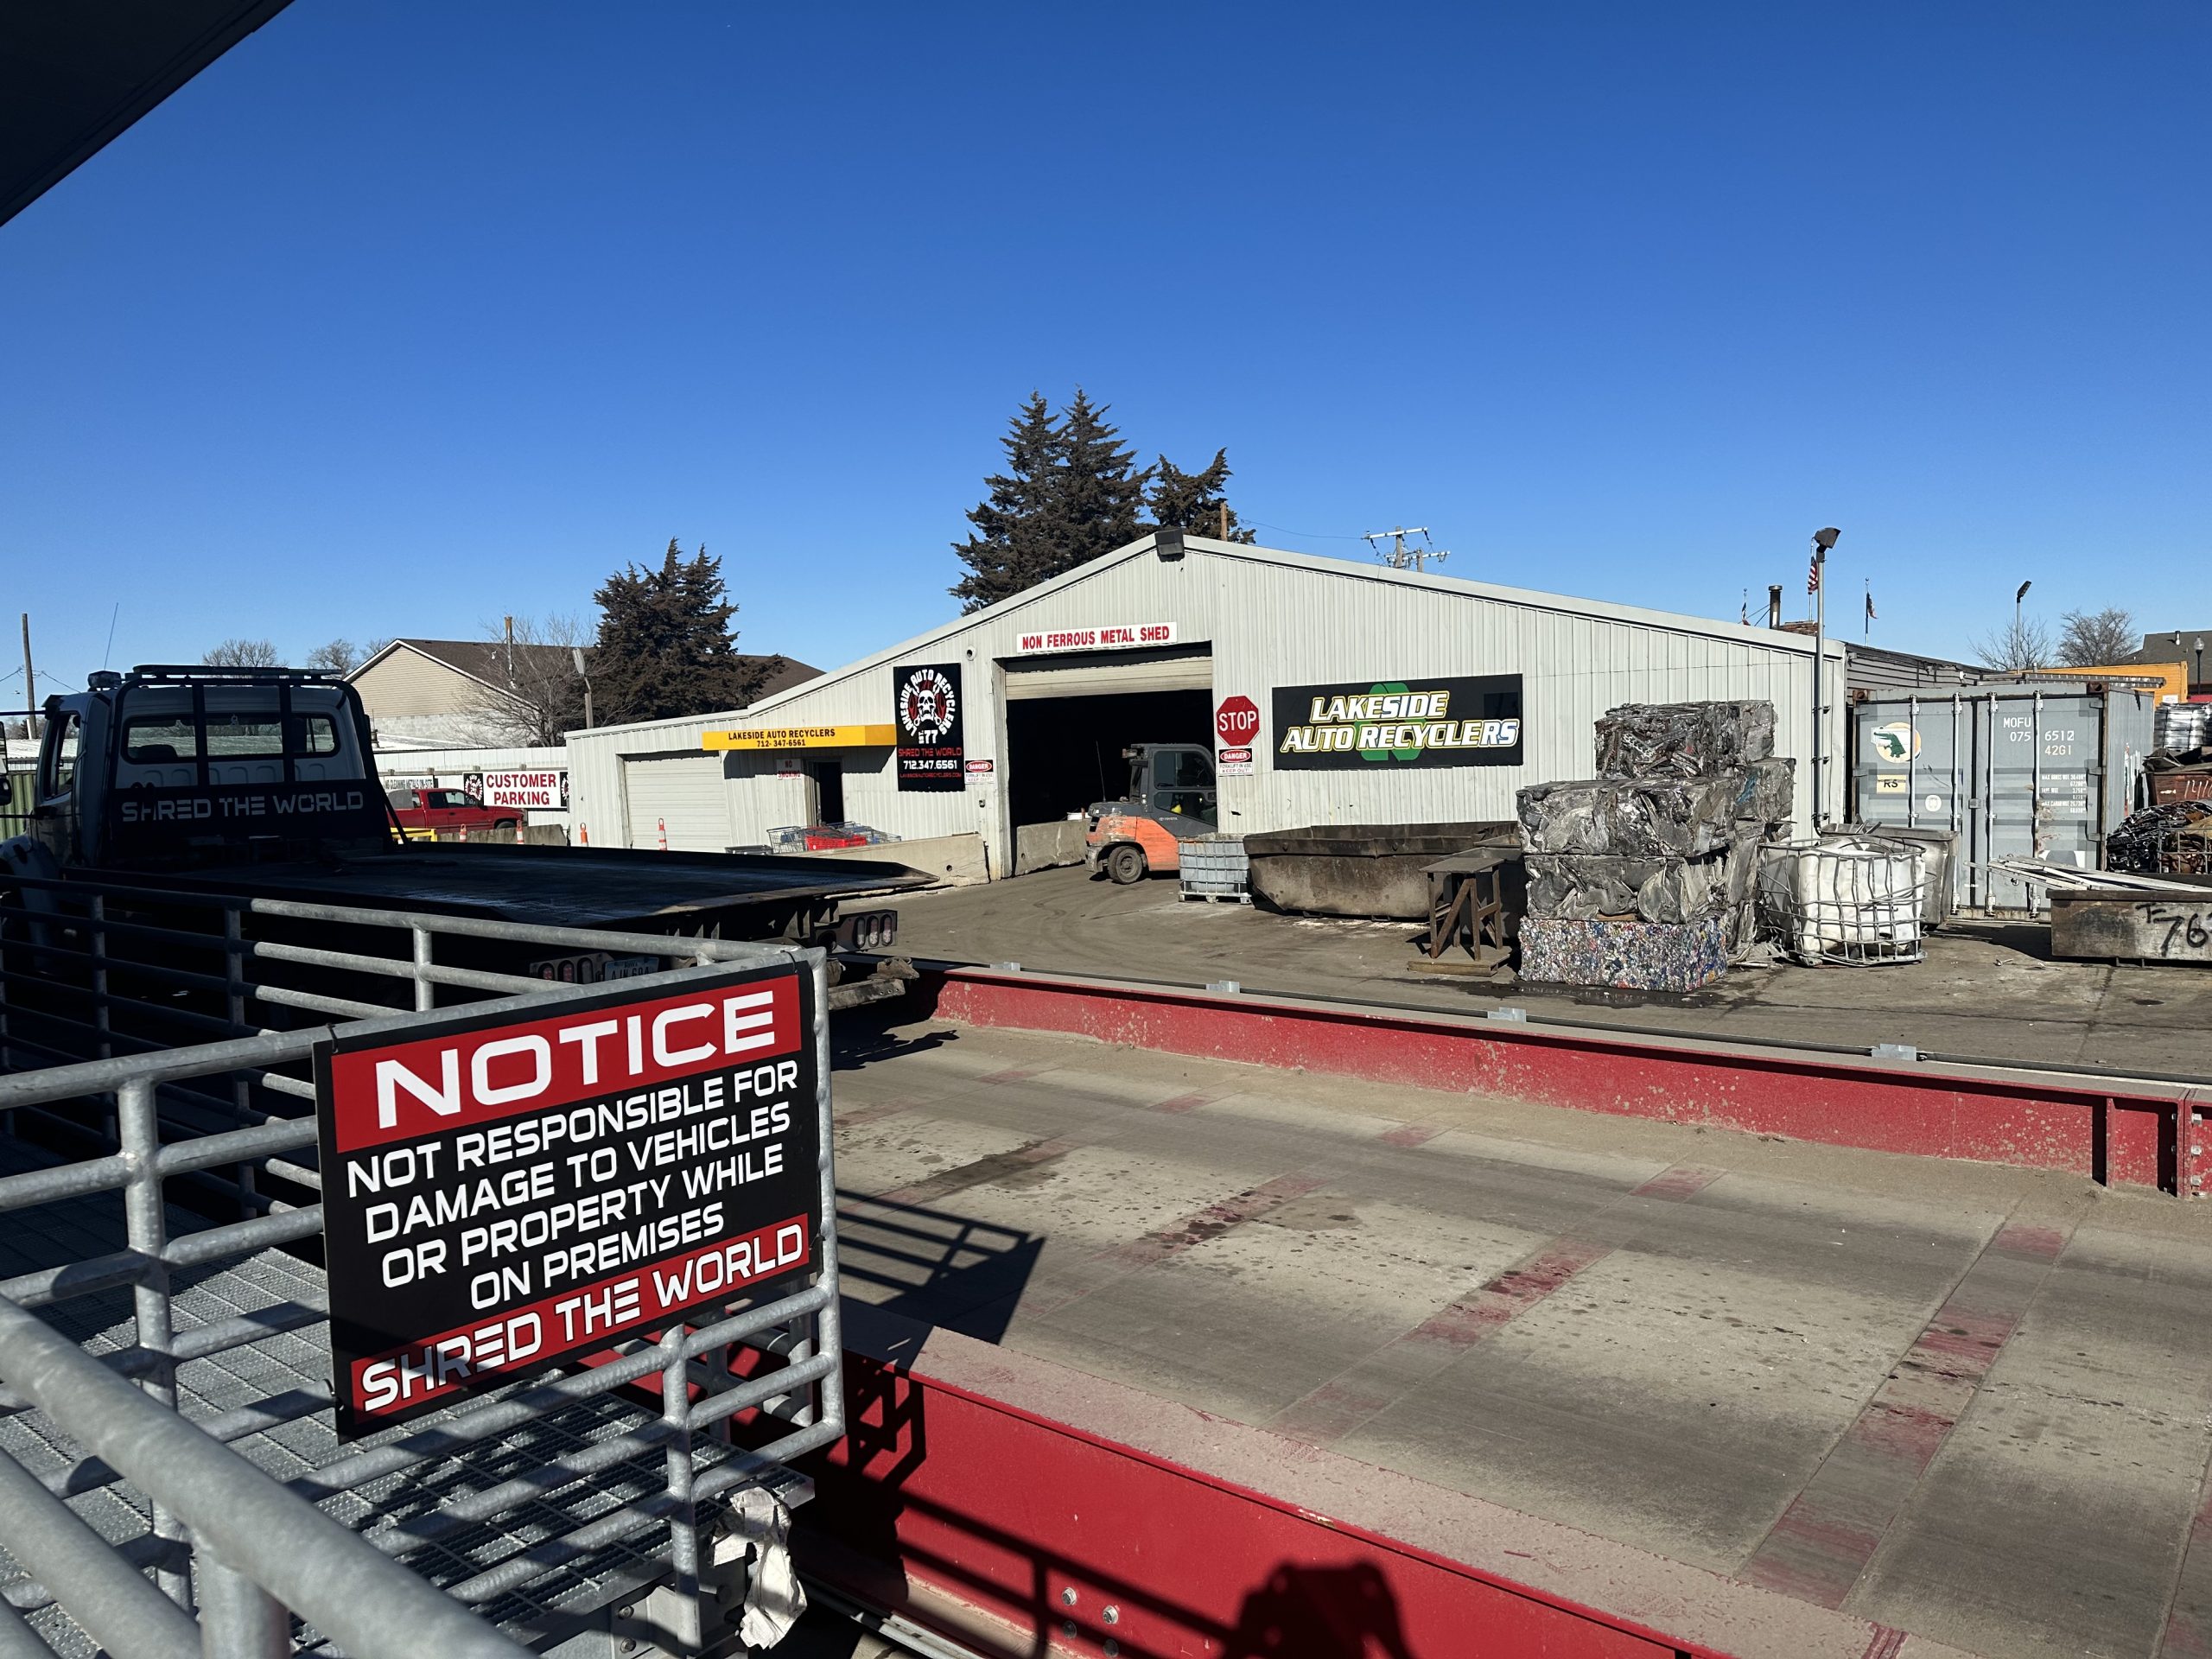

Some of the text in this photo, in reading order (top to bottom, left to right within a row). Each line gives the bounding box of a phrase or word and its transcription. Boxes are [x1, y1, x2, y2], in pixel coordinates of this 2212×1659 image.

[1022, 626, 1170, 650] NON FERROUS METAL SHED
[900, 683, 918, 736] LAKESIDE
[910, 669, 934, 686] AUTO
[1310, 691, 1449, 723] LAKESIDE
[1219, 711, 1256, 731] STOP
[2003, 717, 2031, 728] MOFU
[728, 728, 836, 741] LAKESIDE AUTO RECYCLERS
[925, 729, 938, 744] 77
[1280, 719, 1519, 752] AUTO RECYCLERS
[2010, 731, 2031, 741] 075
[899, 747, 963, 757] SHRED THE WORLD
[2044, 745, 2071, 755] 42G1
[903, 760, 957, 770] 712.347.6561
[486, 773, 556, 788] CUSTOMER
[1884, 779, 1898, 788] RS
[122, 791, 364, 822] SHRED THE WORLD
[493, 791, 550, 805] PARKING
[376, 991, 775, 1128] NOTICE
[347, 1060, 798, 1198] NOT RESPONSIBLE FOR
[365, 1101, 791, 1244] DAMAGE TO VEHICLES
[382, 1143, 783, 1288] OR PROPERTY WHILE
[471, 1202, 724, 1310] ON PREMISES
[361, 1224, 803, 1412] SHRED THE WORLD
